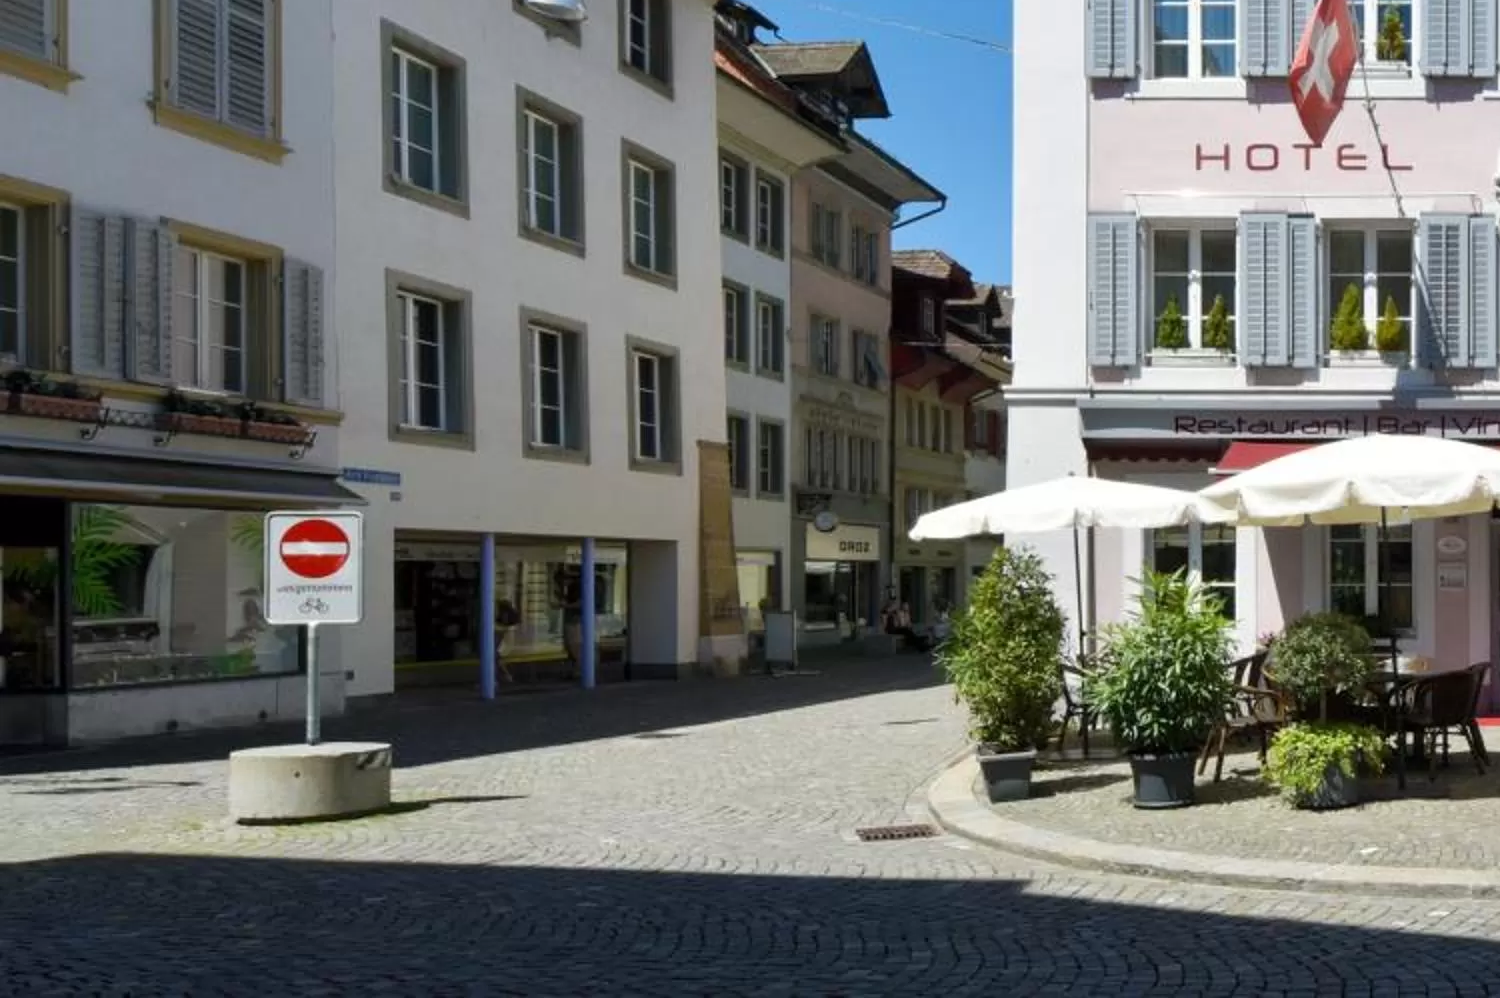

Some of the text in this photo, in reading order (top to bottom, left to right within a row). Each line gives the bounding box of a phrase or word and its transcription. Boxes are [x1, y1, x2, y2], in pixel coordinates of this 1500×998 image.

[1195, 142, 1414, 172] HOTEL
[1173, 414, 1357, 436] Restaurant
[1376, 415, 1433, 436] Bar
